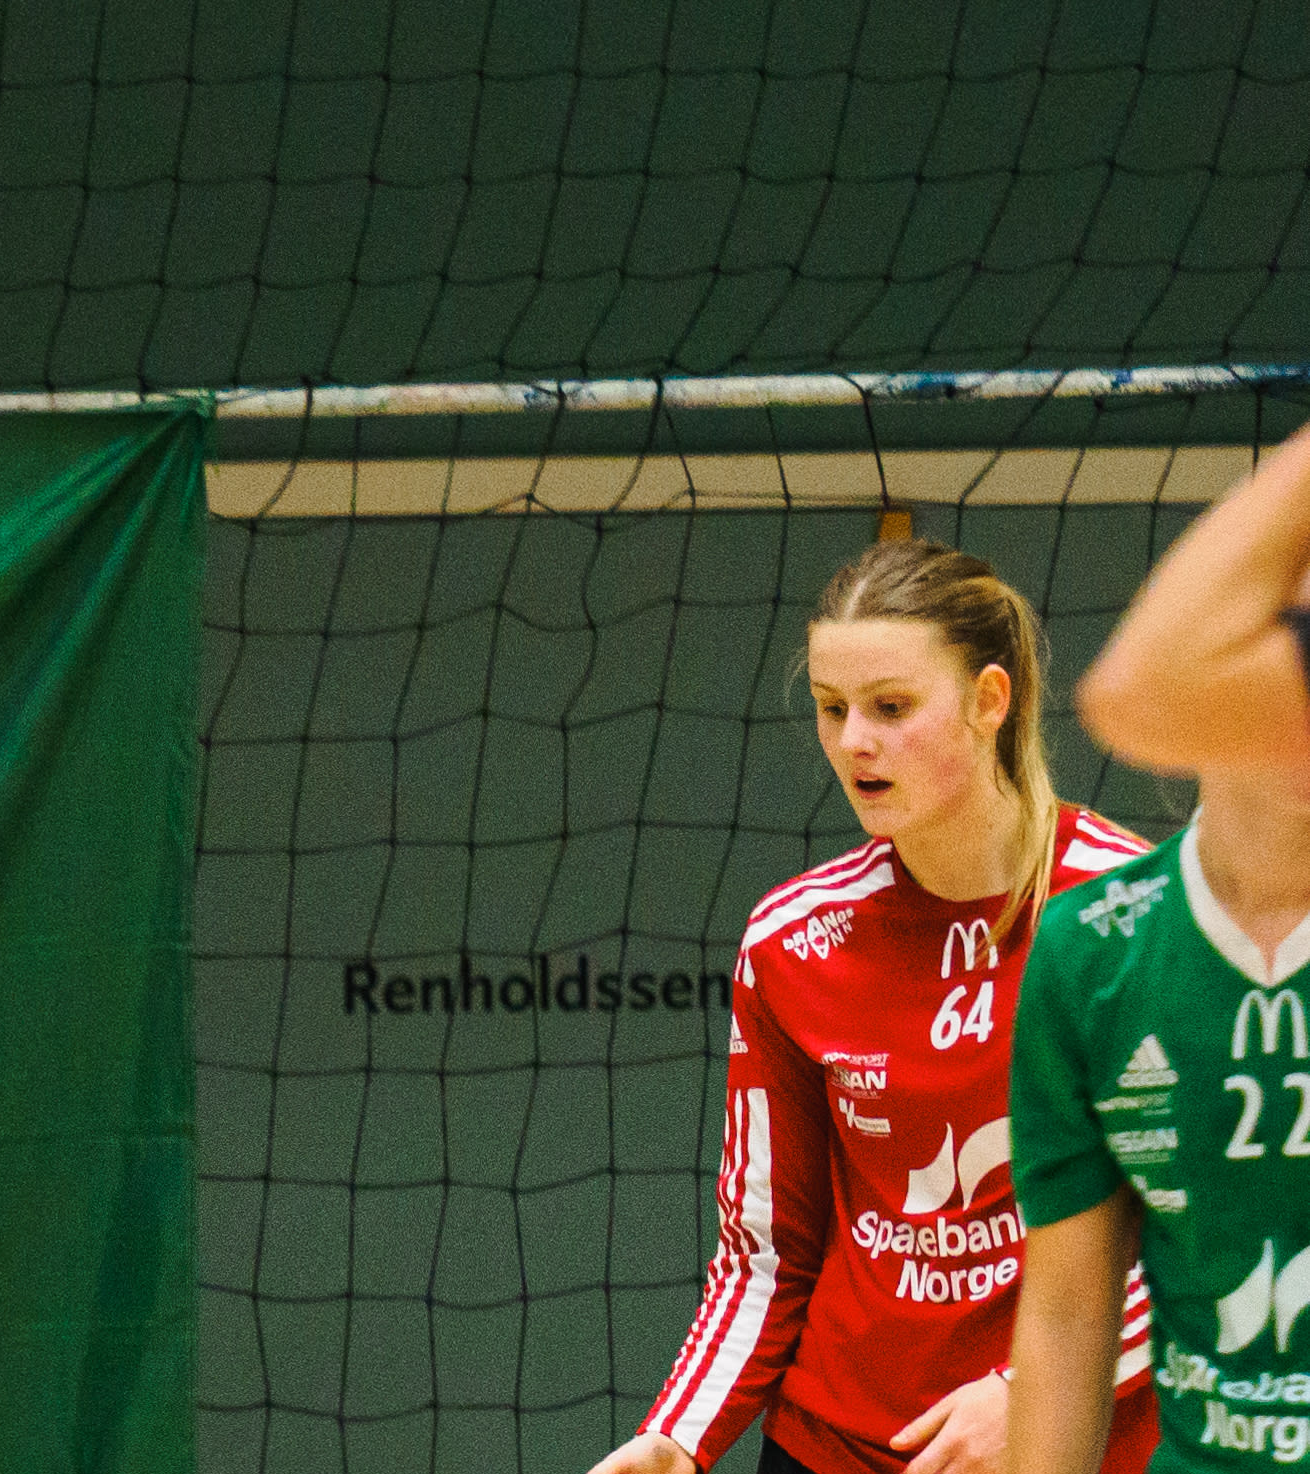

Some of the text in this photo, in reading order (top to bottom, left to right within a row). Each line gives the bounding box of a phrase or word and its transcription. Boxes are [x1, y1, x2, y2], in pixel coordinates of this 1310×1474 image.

[930, 981, 994, 1050] 64
[1224, 1073, 1310, 1156] 22
[896, 1257, 1019, 1303] Norge
